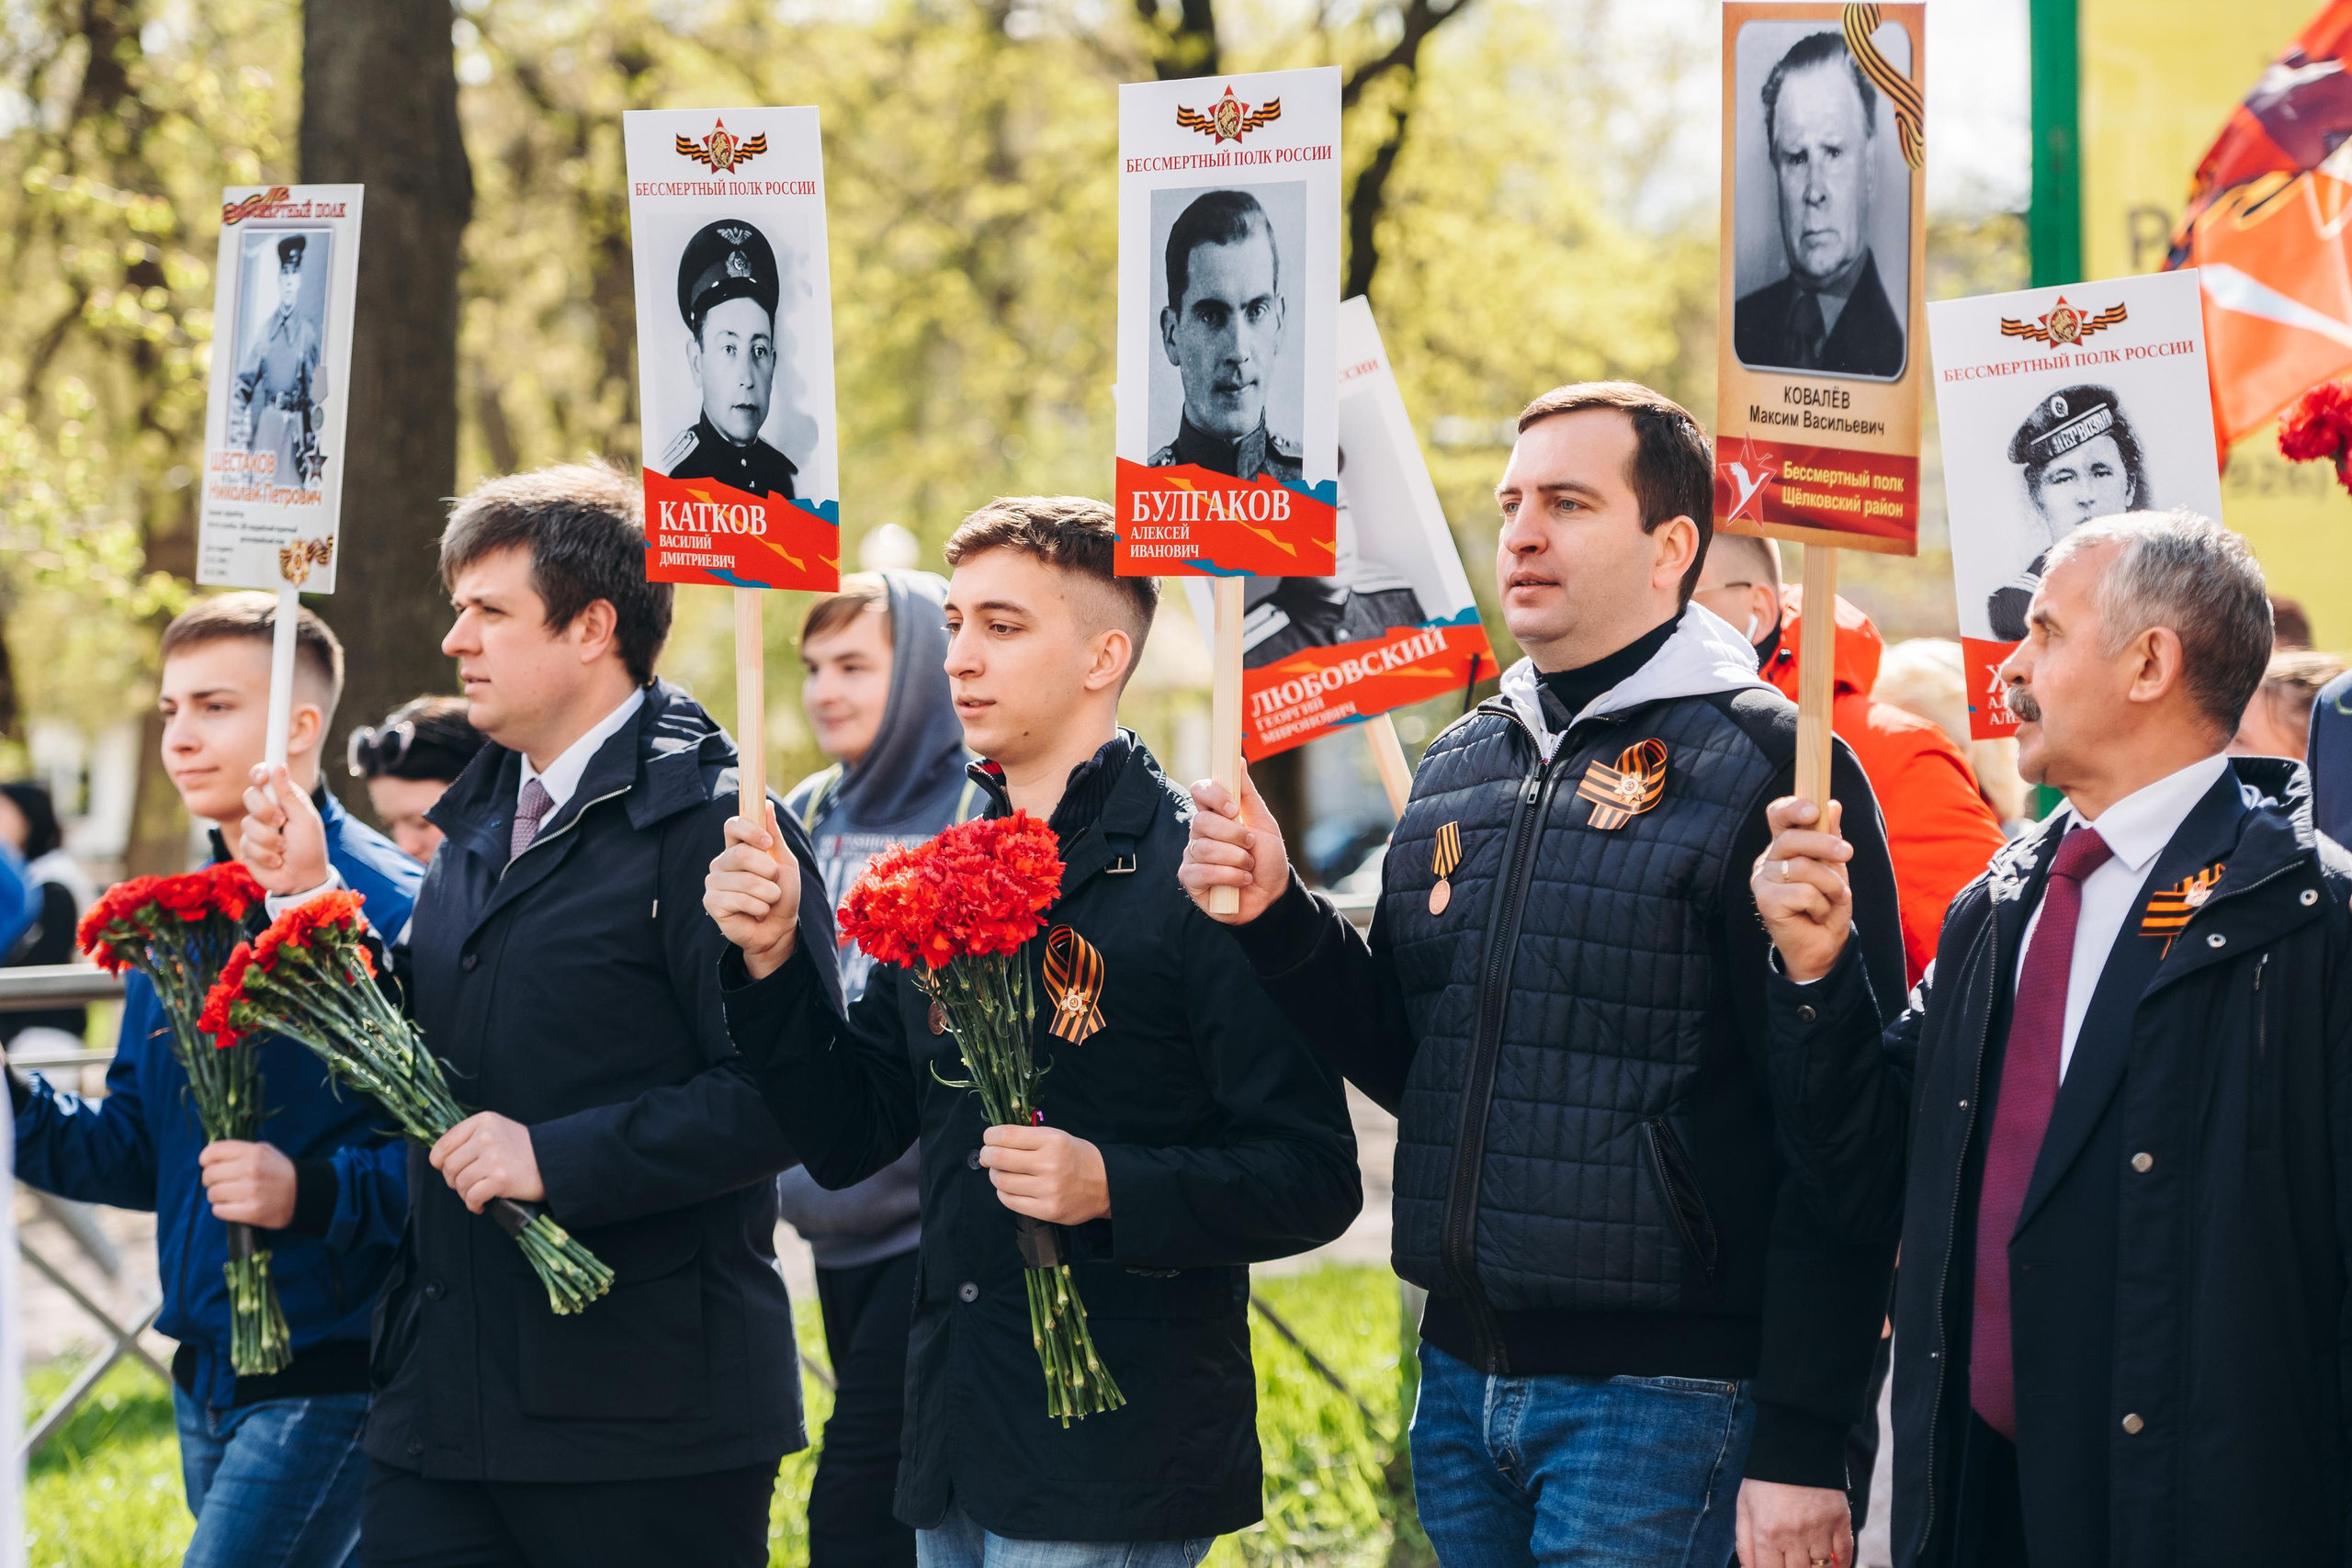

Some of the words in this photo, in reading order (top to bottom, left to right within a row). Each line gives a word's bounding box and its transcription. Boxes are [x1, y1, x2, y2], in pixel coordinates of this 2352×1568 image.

[1126, 149, 1230, 173] БЕССМЕРТНЫЙ
[1234, 150, 1272, 165] ПОЛК
[1275, 145, 1332, 163] РОССИИ
[635, 178, 726, 197] БЕССМЕРТНЫЙ
[729, 182, 763, 196] ПОЛК
[765, 181, 816, 195] РОССИИ
[1943, 353, 2071, 383] БЕССМЕРТНЫЙ
[2075, 349, 2121, 367] ПОЛК
[2125, 340, 2195, 361] РОССИИ
[1783, 386, 1850, 409] КОВАЛЁВ
[1749, 405, 1799, 426] Максим
[1803, 411, 1884, 435] Васильевич
[210, 452, 275, 475] ШЕСТАКОВ
[1783, 460, 1870, 488] Бессмертный
[1873, 475, 1905, 492] полк
[209, 480, 260, 502] Николай
[264, 482, 322, 508] Петрович
[1131, 490, 1291, 522] БУЛГАКОВ
[1781, 486, 1861, 513] Щёлковский
[1864, 498, 1904, 518] район
[659, 501, 767, 536] КАТКОВ
[1130, 523, 1190, 540] АЛЕКСЕЙ
[659, 534, 712, 549] ВАСИЛИЙ
[1130, 544, 1200, 558] ИВАНОВИЧ
[659, 551, 735, 569] ДМИТРИЕВИЧ
[1250, 625, 1449, 718] ЛЮБОВСКИЙ
[1254, 696, 1326, 732] ГЕОРГИЙ
[1260, 700, 1358, 746] МИРОНОВИЧ
